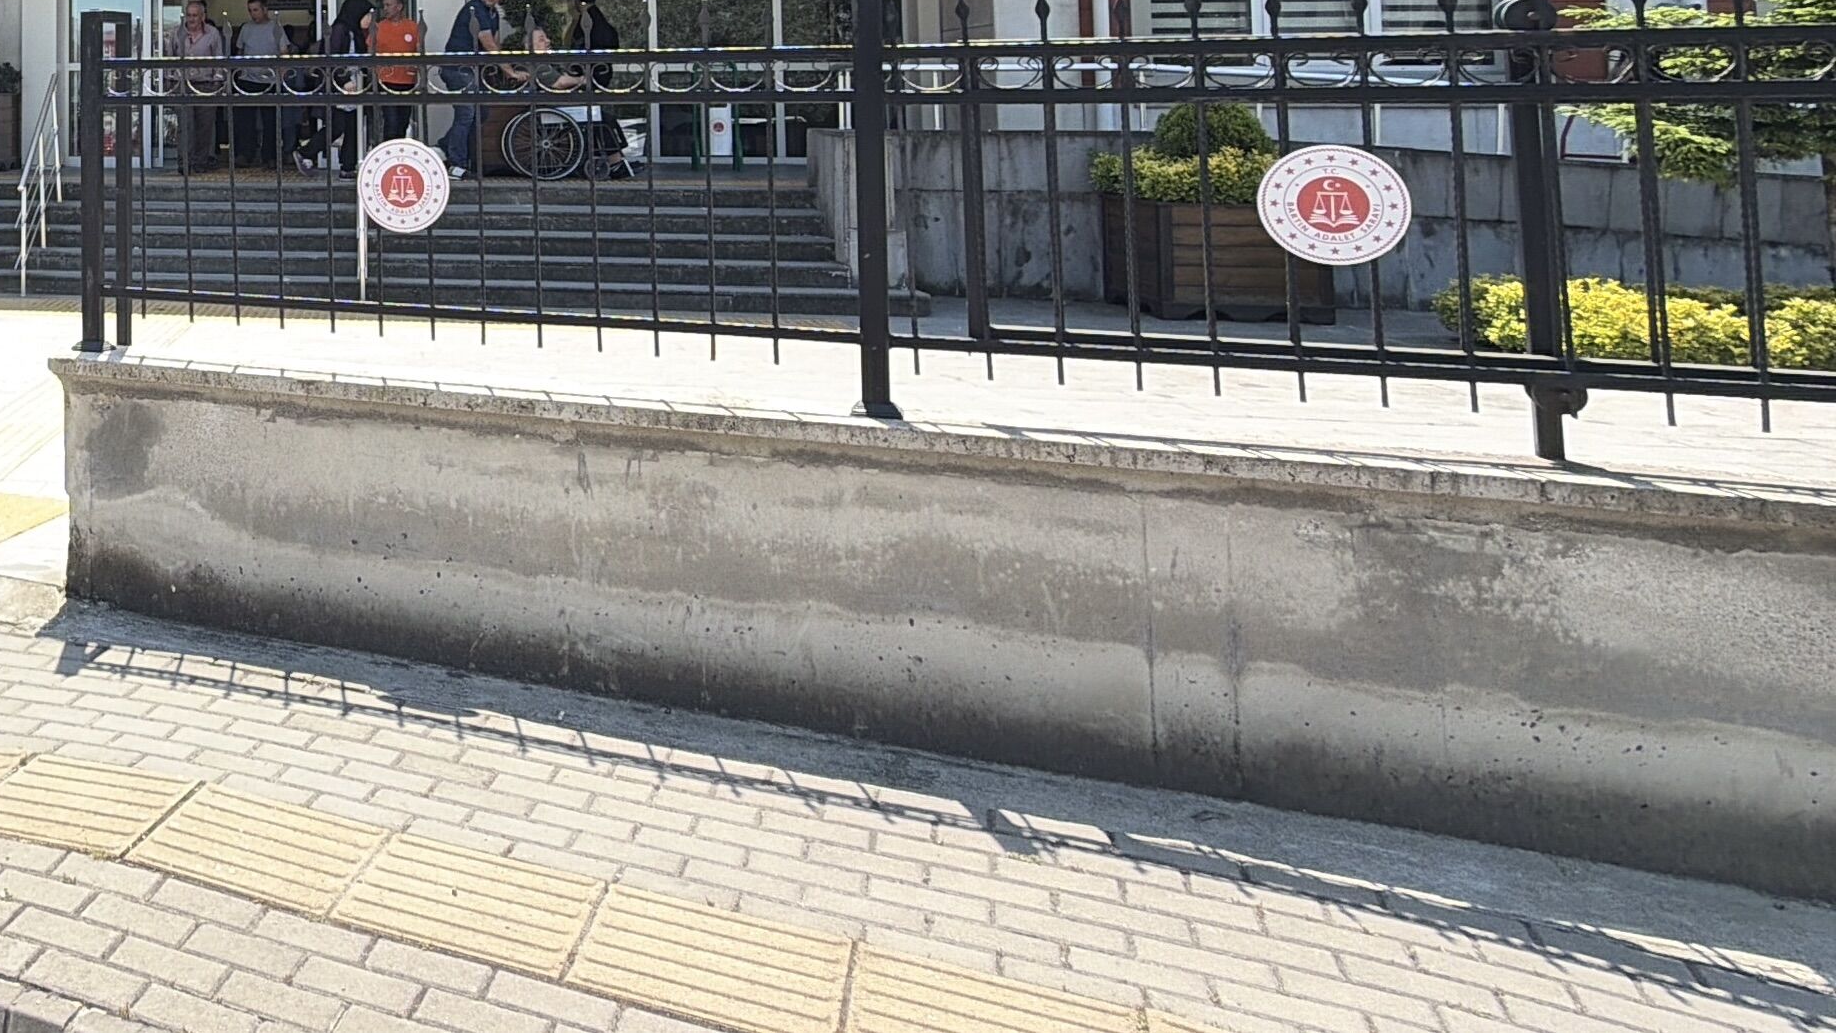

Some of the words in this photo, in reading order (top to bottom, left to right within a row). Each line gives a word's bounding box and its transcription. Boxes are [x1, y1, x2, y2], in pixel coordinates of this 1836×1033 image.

[1286, 201, 1310, 232] BARTIN
[1314, 233, 1356, 242] ADALET
[1361, 203, 1381, 234] SARAYI
